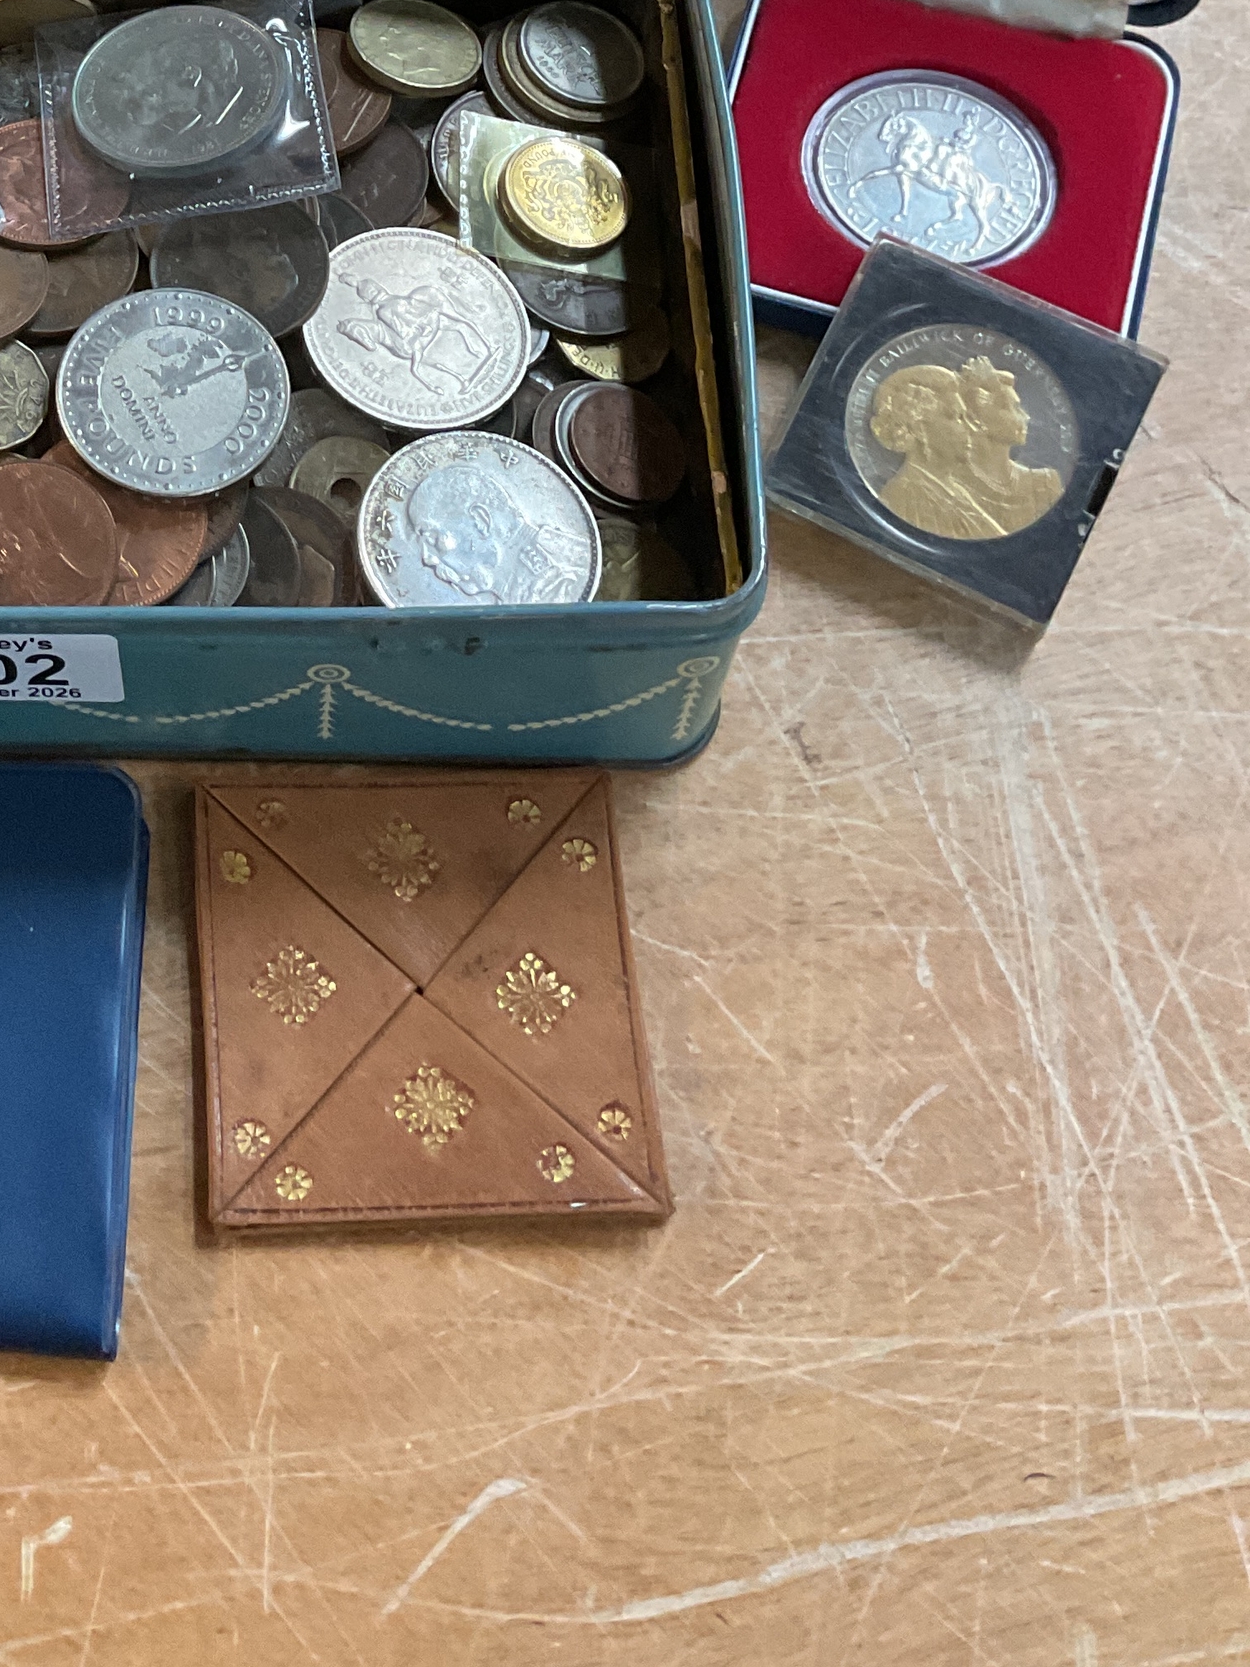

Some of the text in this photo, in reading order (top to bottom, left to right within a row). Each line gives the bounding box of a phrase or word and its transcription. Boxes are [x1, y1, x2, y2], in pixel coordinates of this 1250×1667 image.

[153, 305, 225, 336] 1999
[77, 397, 198, 476] POUNDS
[111, 374, 156, 442] DOMINI
[143, 395, 180, 445] ANNO
[224, 389, 270, 455] 2000
[27, 687, 82, 699] 2026
